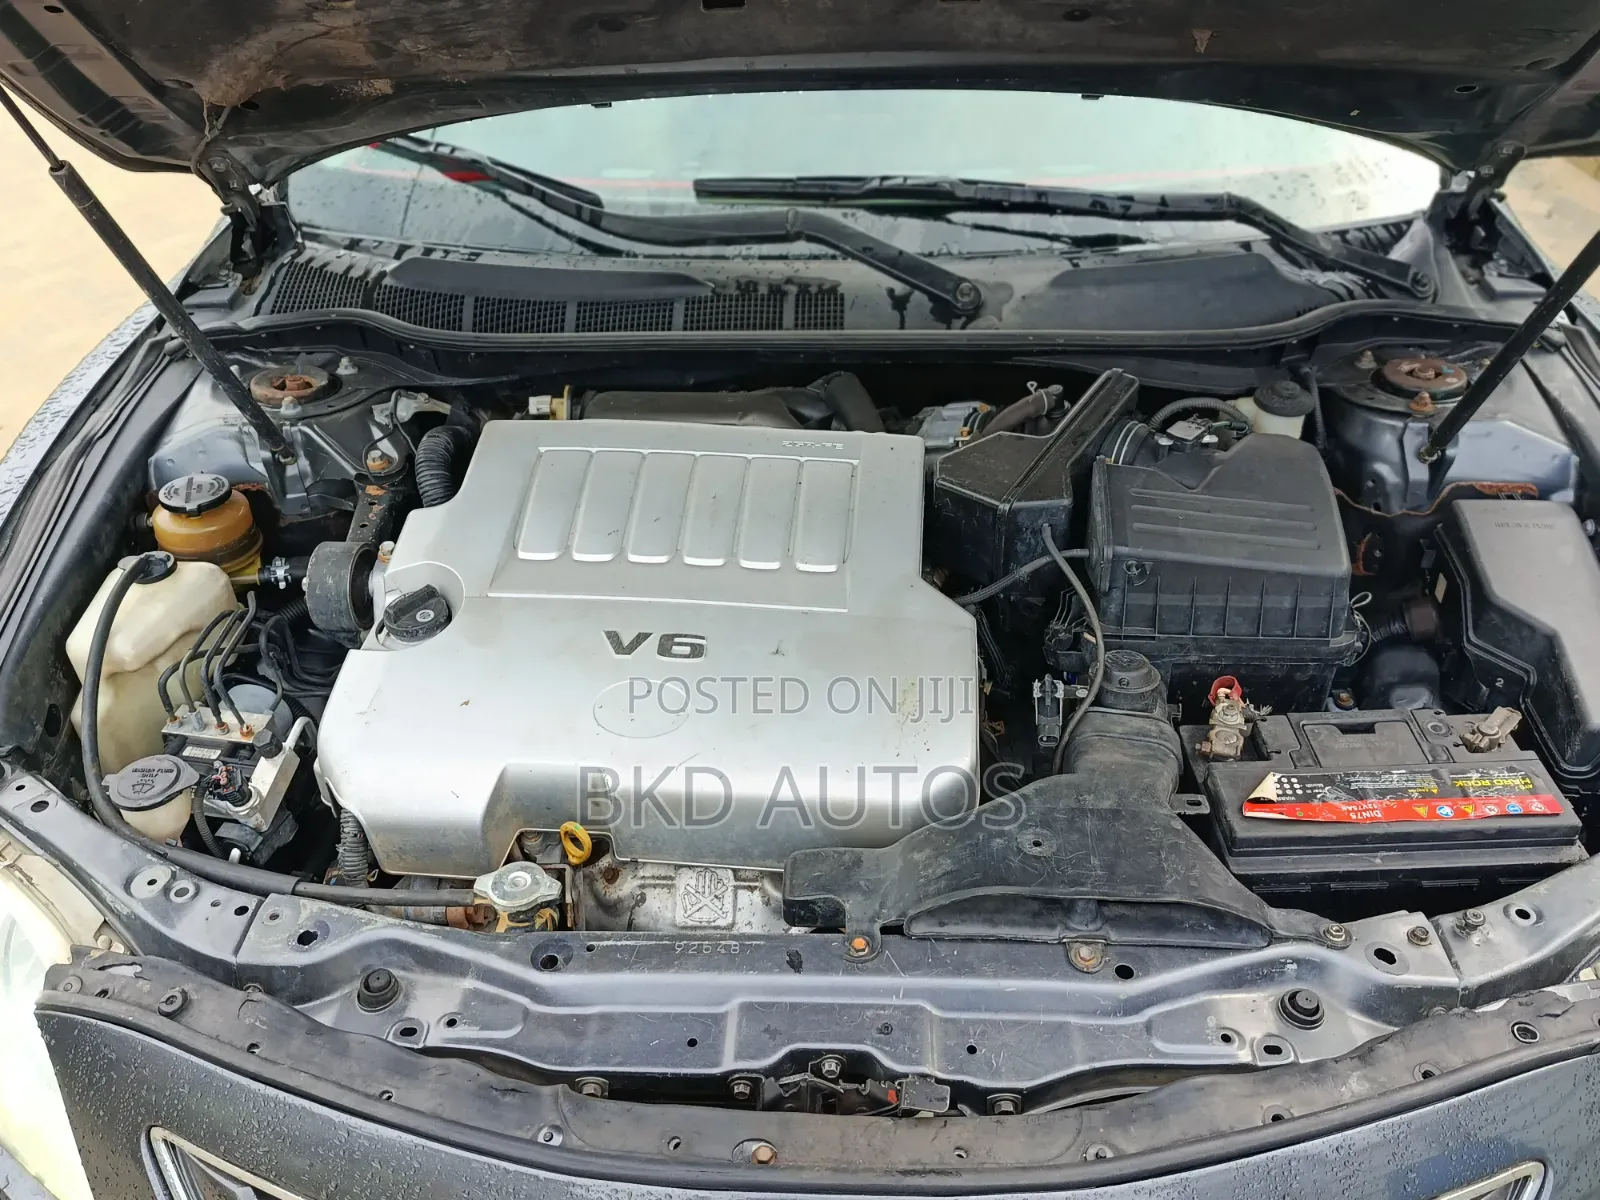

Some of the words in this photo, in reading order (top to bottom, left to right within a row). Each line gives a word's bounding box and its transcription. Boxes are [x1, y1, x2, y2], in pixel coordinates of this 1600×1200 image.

[601, 630, 707, 661] V6
[1495, 677, 1504, 688] 2
[1455, 779, 1490, 787] ROCK
[1493, 777, 1530, 787] HARD
[1349, 810, 1382, 820] DIN75
[675, 941, 740, 954] 92648
